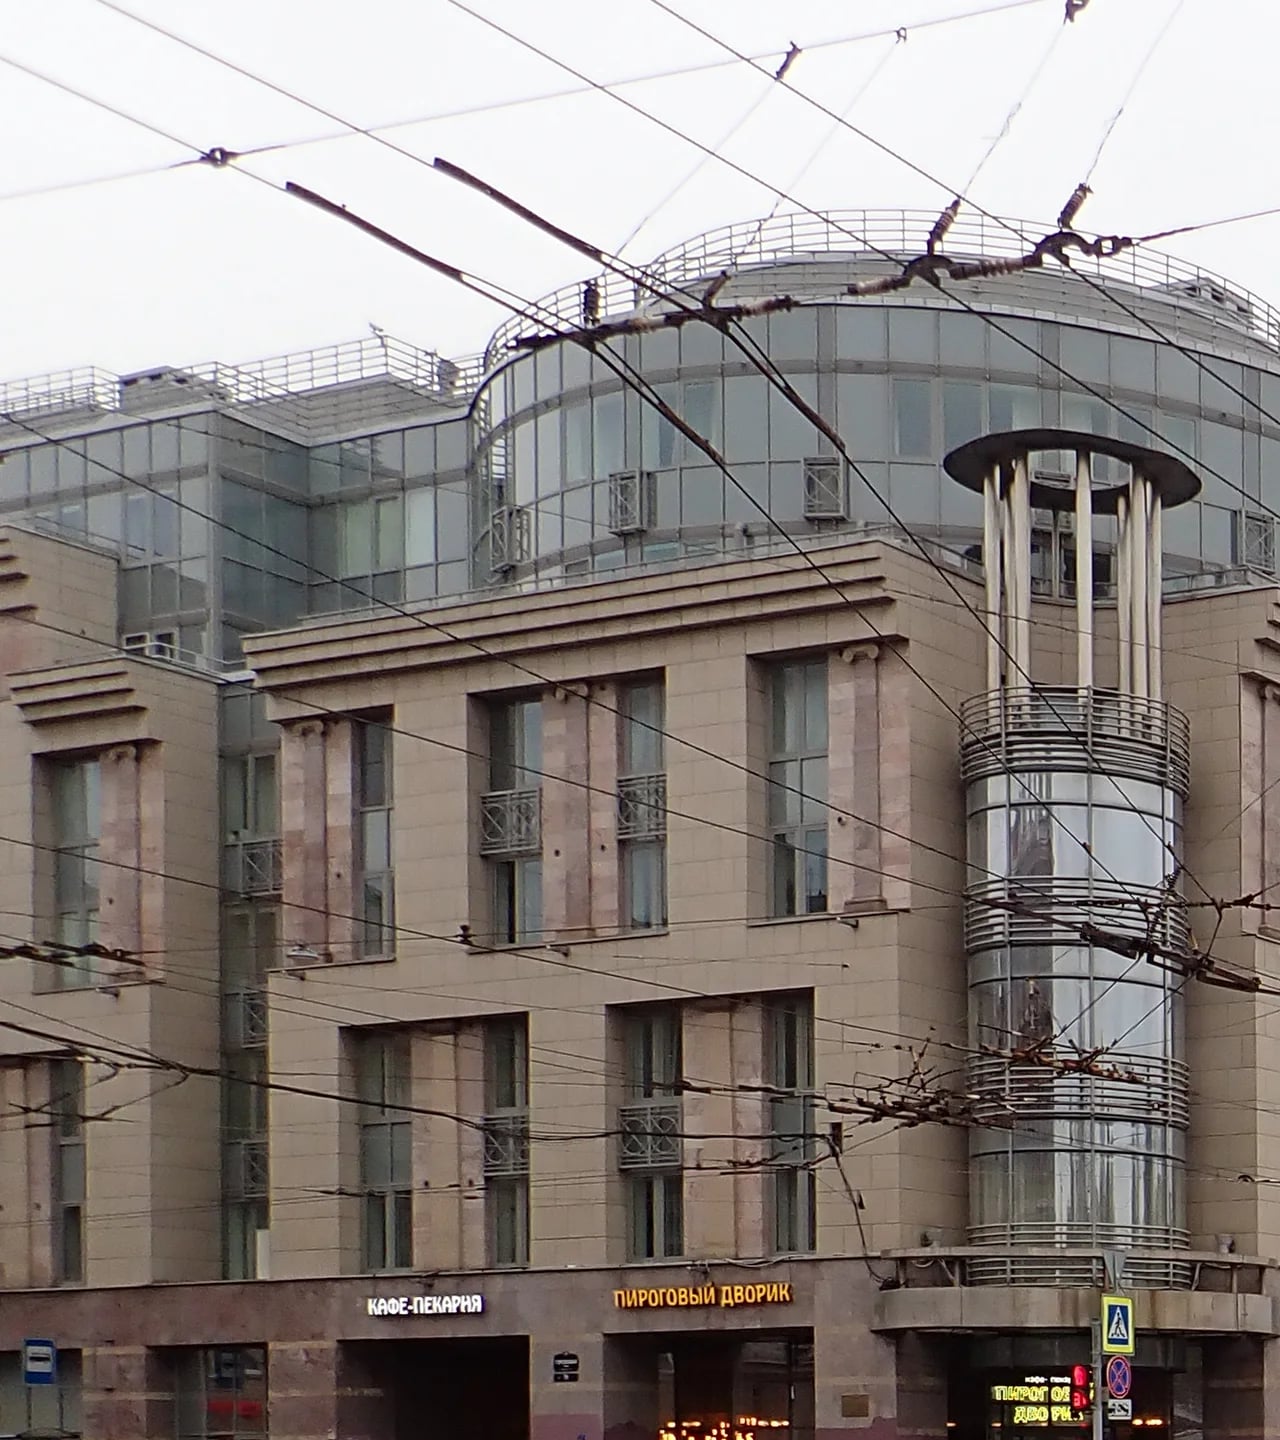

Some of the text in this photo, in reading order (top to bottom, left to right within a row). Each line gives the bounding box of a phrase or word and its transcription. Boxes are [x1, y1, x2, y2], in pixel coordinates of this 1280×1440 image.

[367, 1295, 482, 1315] КАФЕ-ПЕКАРНЯ
[613, 1282, 790, 1308] ПИРОГОВЫЙ ДВОРИК
